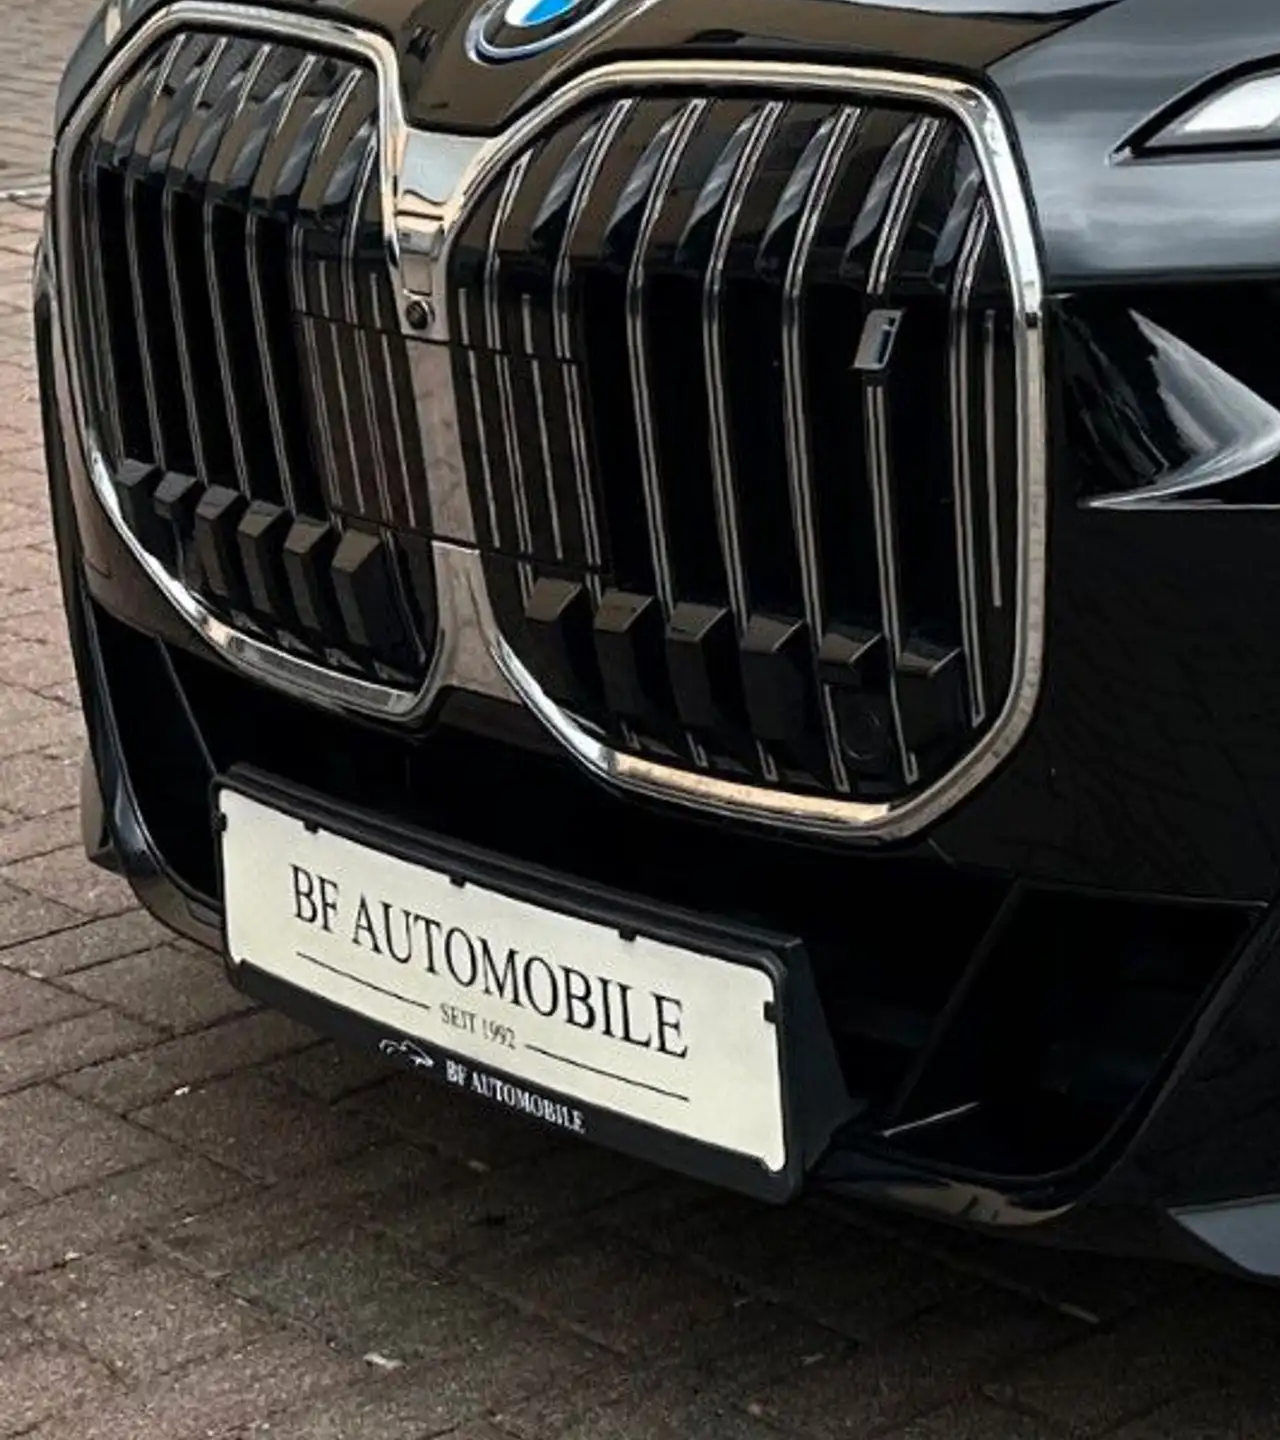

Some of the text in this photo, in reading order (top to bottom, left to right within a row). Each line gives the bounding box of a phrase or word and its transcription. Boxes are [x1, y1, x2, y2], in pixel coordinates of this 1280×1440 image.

[289, 863, 689, 1059] BF AUTOMOBILE
[440, 1003, 516, 1050] SEIT 1992
[446, 1059, 586, 1134] BF AUTOMOBILE
